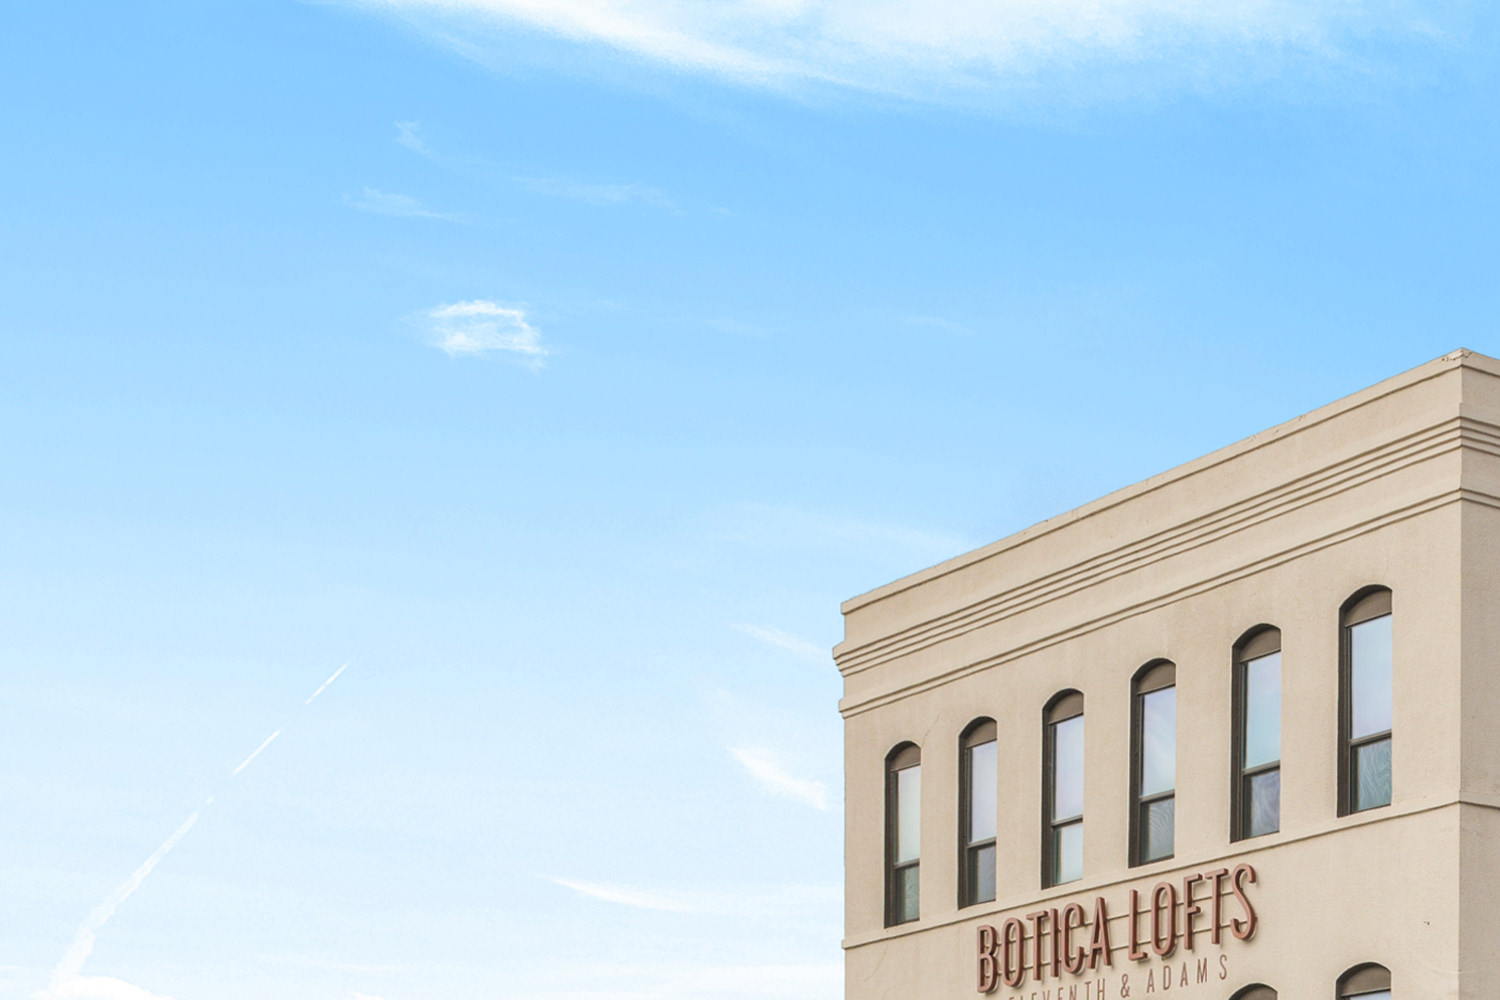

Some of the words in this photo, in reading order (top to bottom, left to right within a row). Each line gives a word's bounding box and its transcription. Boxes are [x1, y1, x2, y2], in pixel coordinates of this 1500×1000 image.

[977, 897, 1112, 993] BOTICA
[1128, 863, 1258, 961] LOFTS
[1120, 973, 1130, 998] &
[1146, 954, 1228, 993] ADAMS
